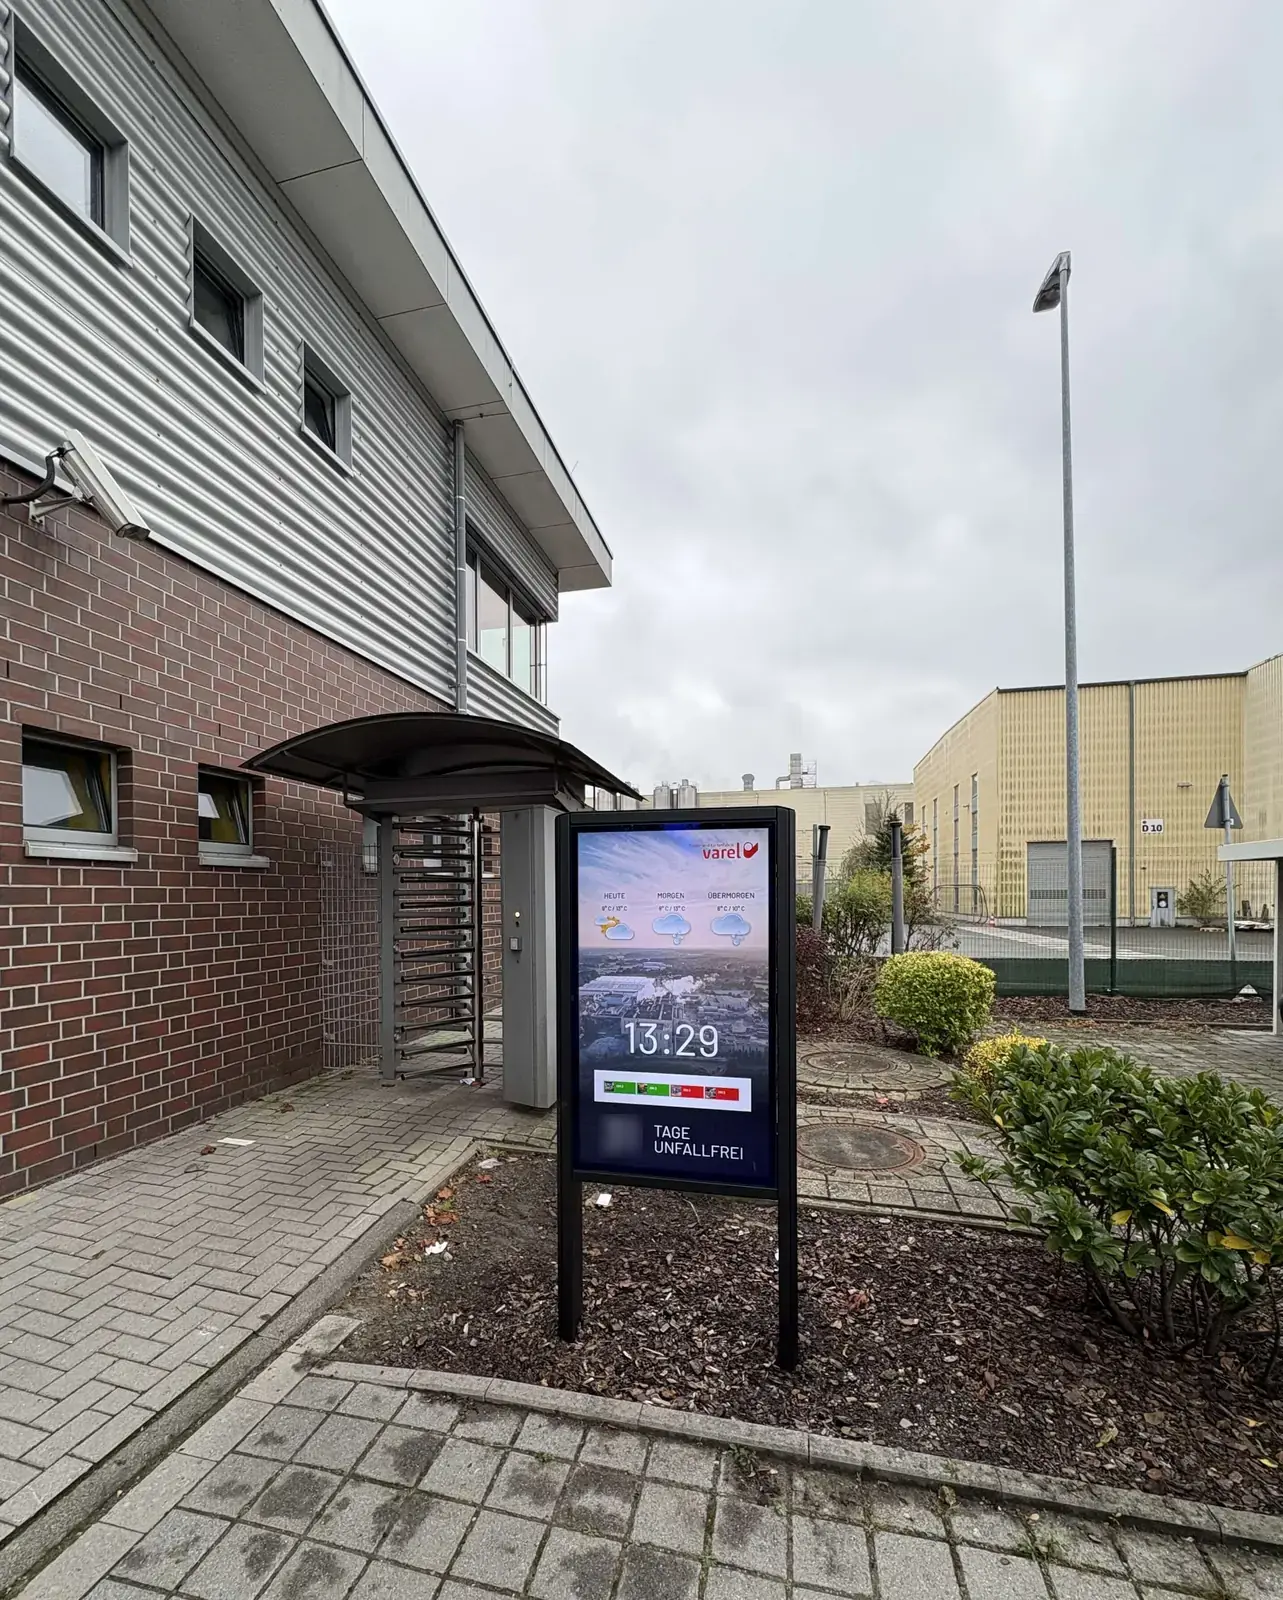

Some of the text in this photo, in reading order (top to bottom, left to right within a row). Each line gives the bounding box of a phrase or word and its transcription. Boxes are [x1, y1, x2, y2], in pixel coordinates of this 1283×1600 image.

[1142, 824, 1163, 832] D 10
[702, 842, 741, 860] varel
[603, 892, 626, 900] HEUTE
[657, 892, 685, 900] MORGEN
[707, 891, 755, 900] ÜBERMORGEN
[624, 1022, 719, 1058] 13:29
[654, 1124, 691, 1140] TAGE
[654, 1140, 744, 1160] UNFALLFREI
